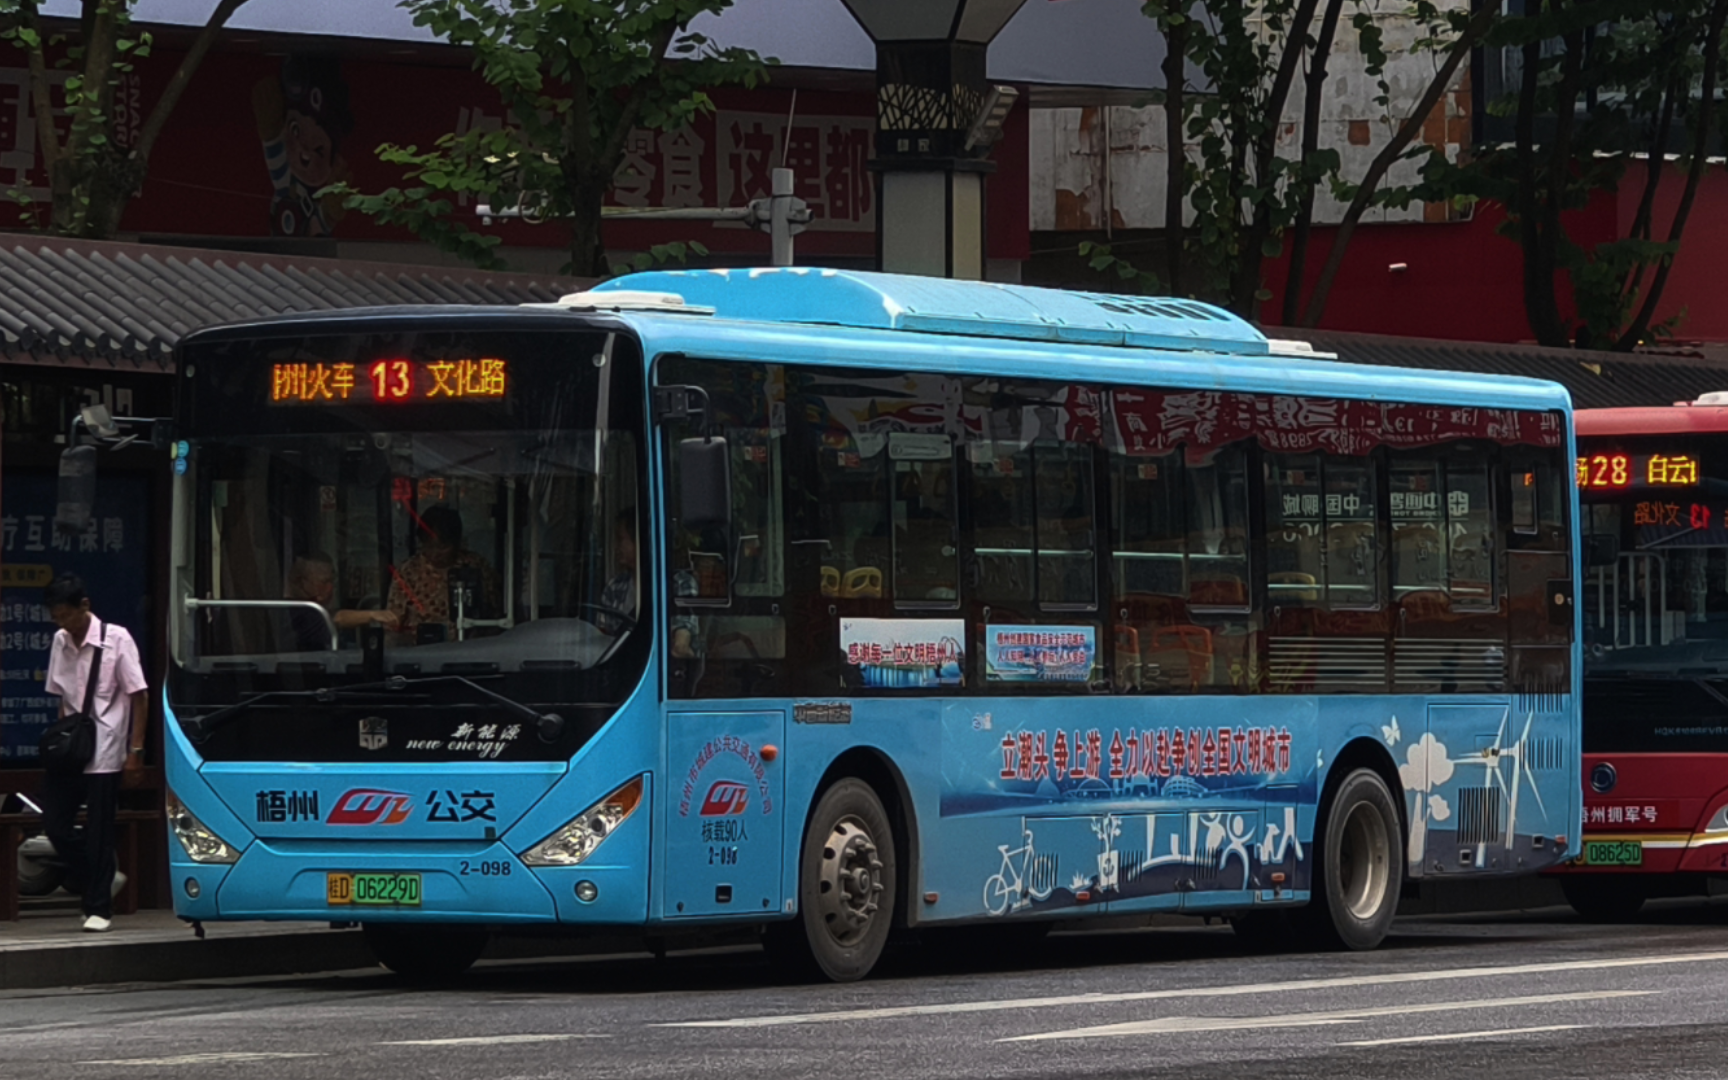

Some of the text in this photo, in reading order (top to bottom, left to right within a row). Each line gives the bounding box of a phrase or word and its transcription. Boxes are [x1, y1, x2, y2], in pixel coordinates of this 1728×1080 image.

[730, 118, 876, 222] 这里都
[372, 361, 411, 398] 13
[426, 359, 506, 397] 文化路
[1592, 455, 1628, 486] 28
[450, 722, 522, 741] 新能源
[405, 740, 509, 759] new energy
[1000, 725, 1293, 781] 立潮头 争上游 全力以赴争创全国文明城市
[255, 789, 497, 823] 梧州 公交
[701, 819, 749, 843] 核载90人
[1589, 843, 1640, 863] 08625D
[459, 860, 512, 877] 2-098
[356, 875, 419, 901] 06229D
